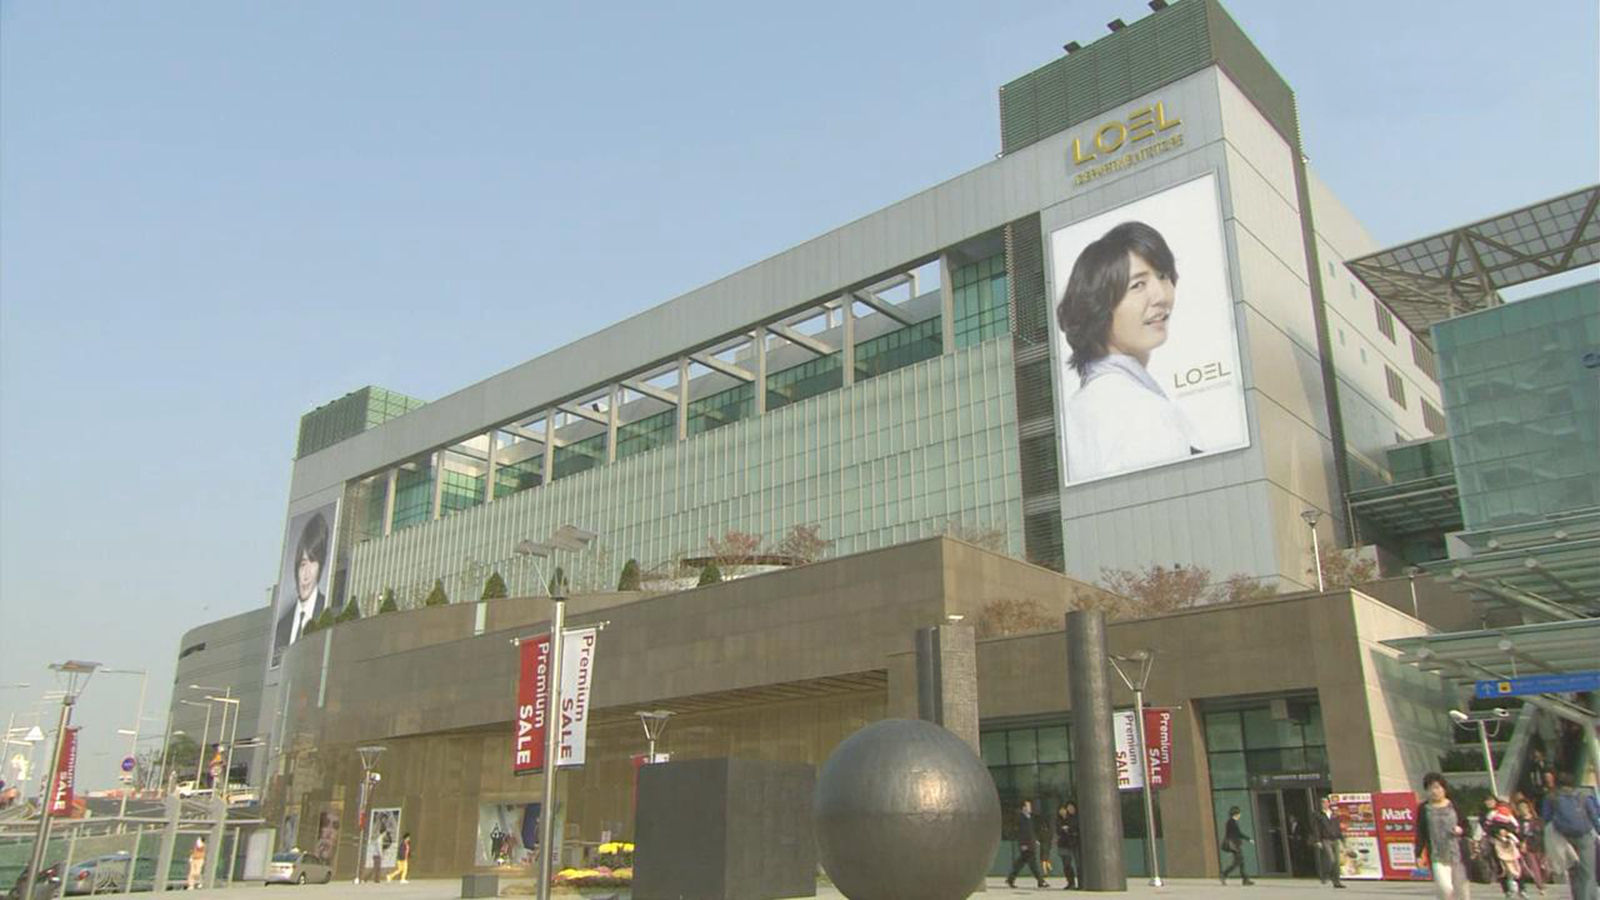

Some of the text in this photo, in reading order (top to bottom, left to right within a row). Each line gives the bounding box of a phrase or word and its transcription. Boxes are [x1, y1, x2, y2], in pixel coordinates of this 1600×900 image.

[1071, 100, 1182, 166] LOEL
[1174, 362, 1231, 389] LOEL
[534, 642, 550, 728] Premium
[575, 635, 594, 721] Premium
[516, 704, 533, 764] SALE
[560, 698, 574, 759] SALE
[1125, 715, 1137, 764] Premium
[1160, 713, 1170, 763] Premium
[53, 772, 66, 810] SALE
[1116, 752, 1130, 786] SALE
[1150, 749, 1161, 784] SALE
[1382, 808, 1413, 820] Mart
